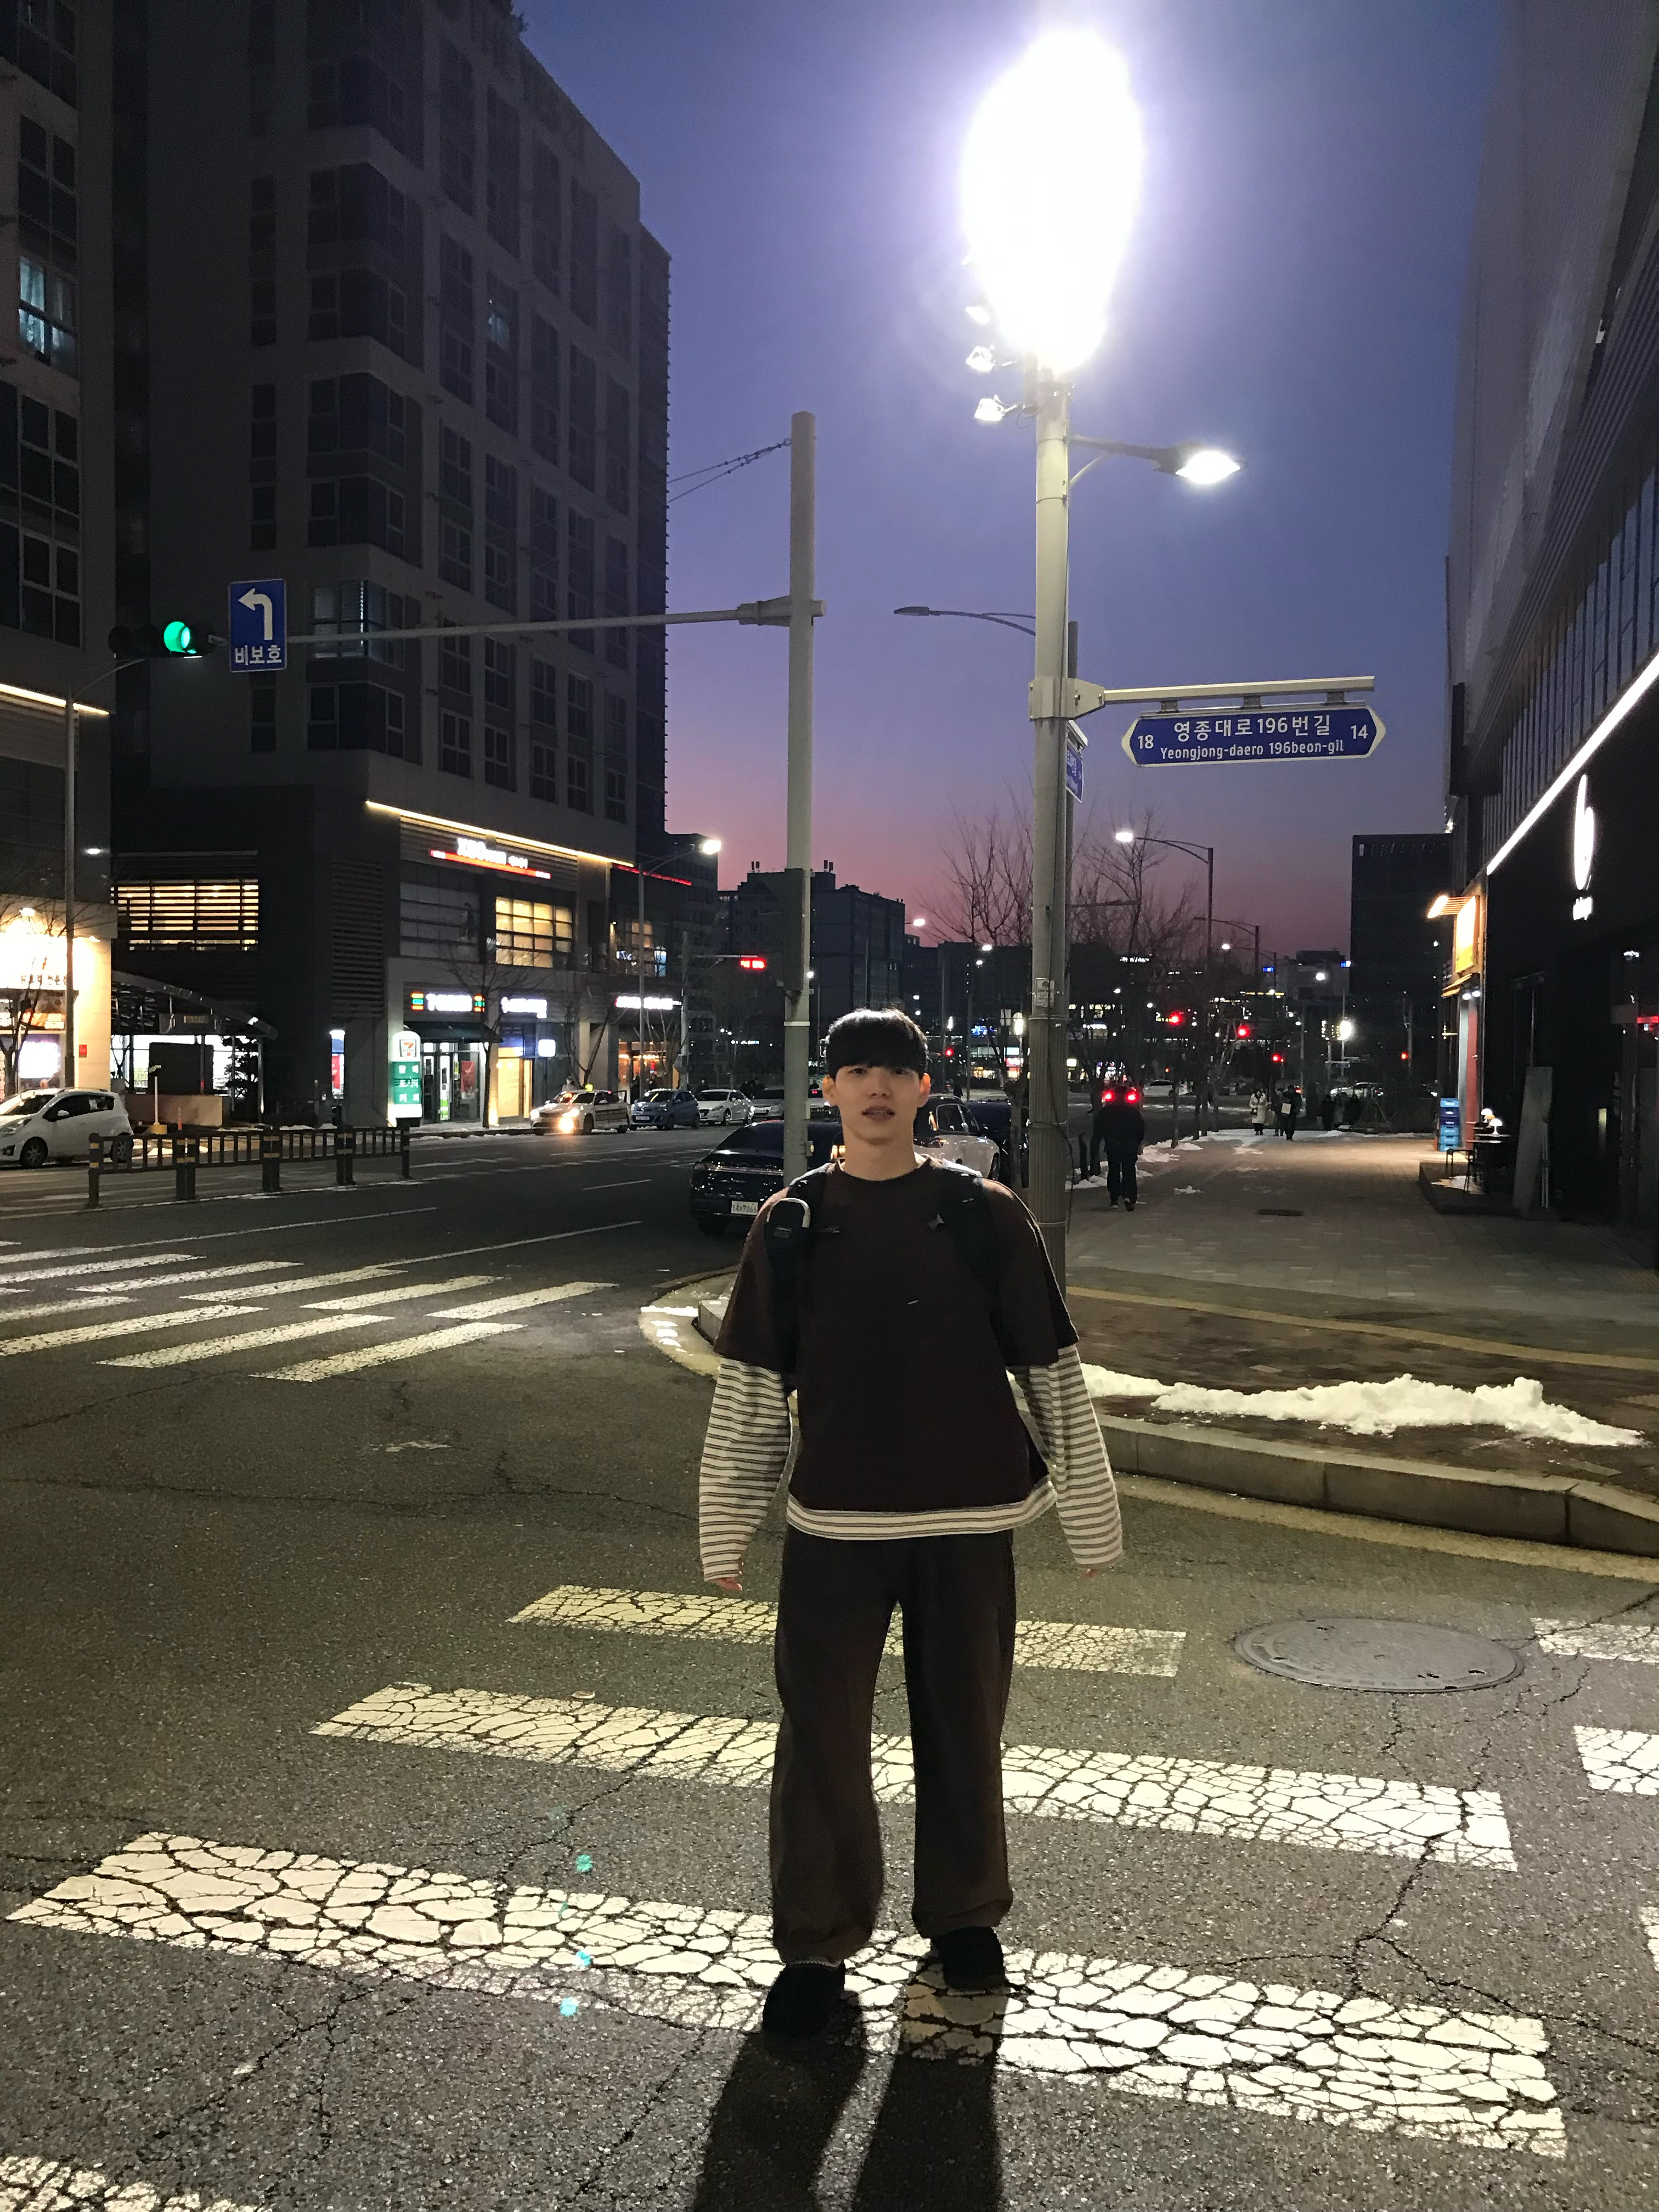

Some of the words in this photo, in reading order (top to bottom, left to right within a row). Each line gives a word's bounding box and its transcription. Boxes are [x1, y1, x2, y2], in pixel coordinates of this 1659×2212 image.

[235, 645, 282, 665] 비보호
[1174, 714, 1330, 742] 영종대로196번길
[1351, 724, 1368, 740] 14
[1137, 734, 1154, 749] 18
[1160, 743, 1263, 761] Yeongjong-daero
[1269, 739, 1344, 755] 196beon-gil
